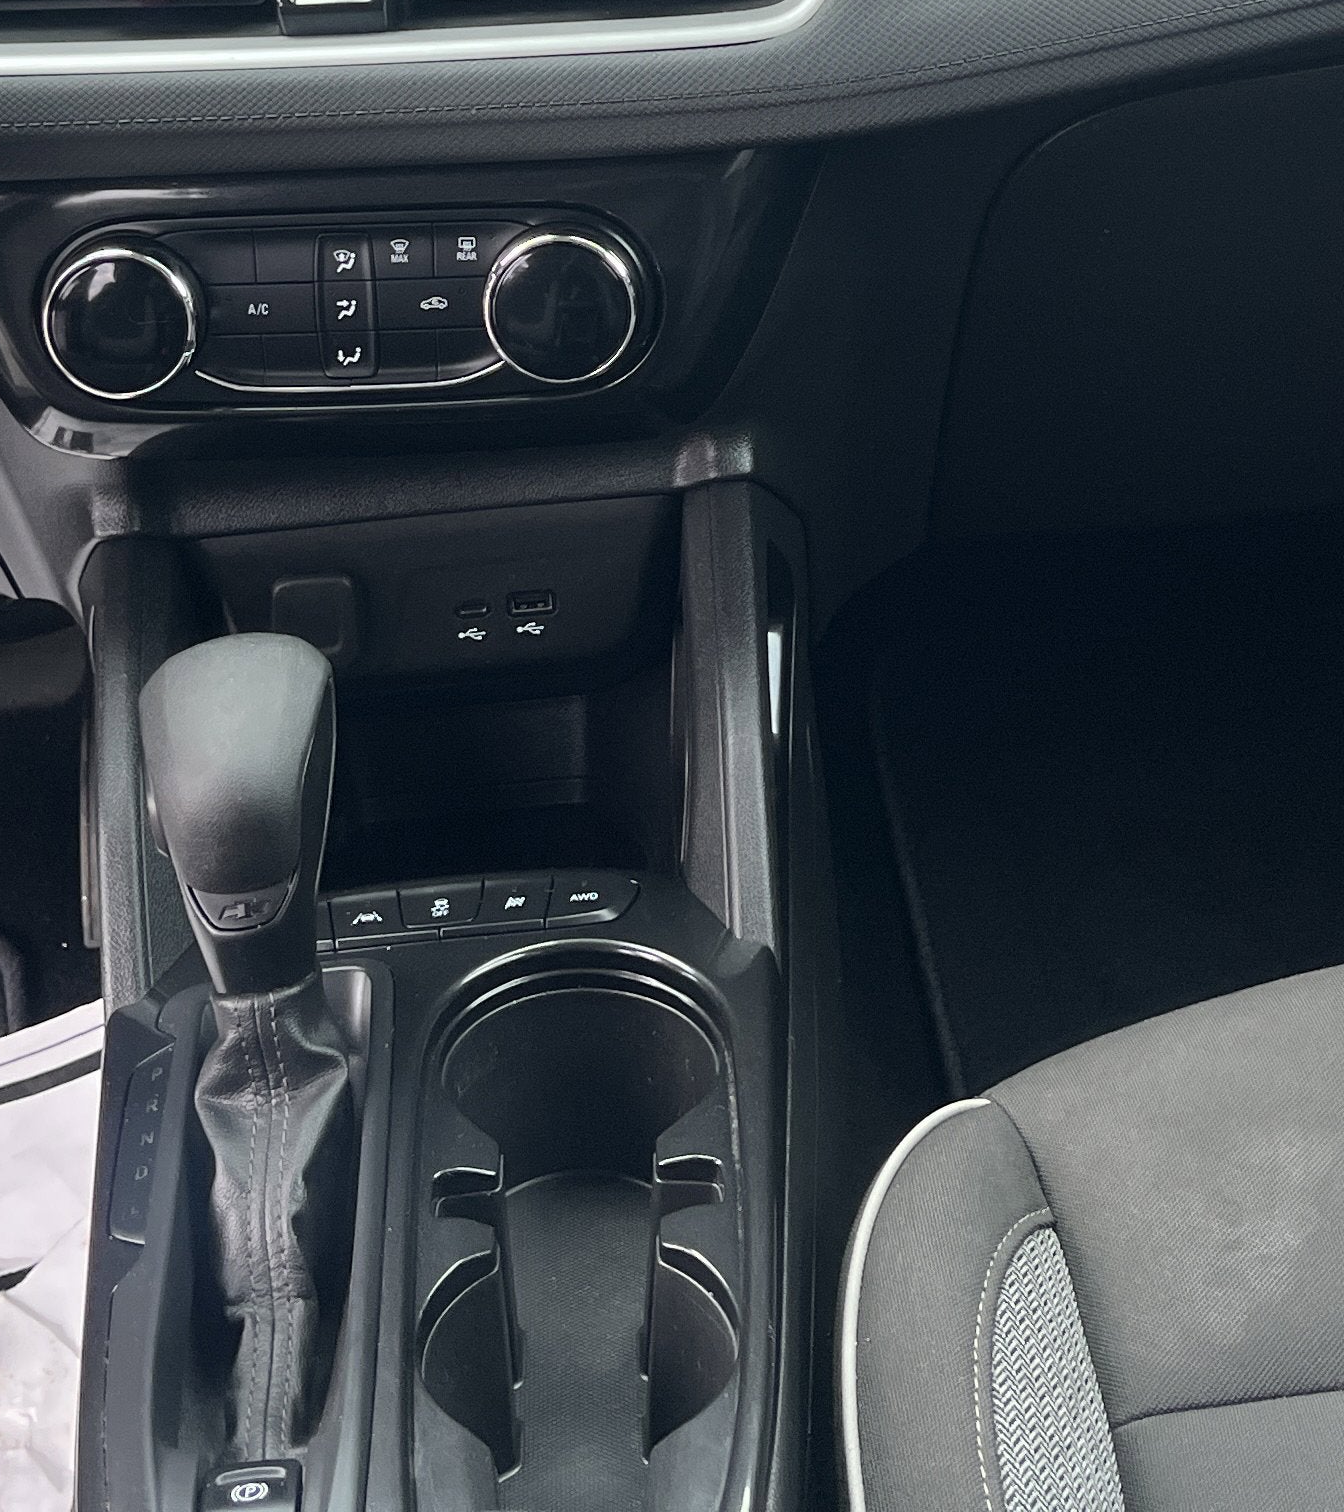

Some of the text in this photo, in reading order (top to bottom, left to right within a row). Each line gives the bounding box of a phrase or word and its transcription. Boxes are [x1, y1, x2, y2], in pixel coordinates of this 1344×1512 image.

[390, 253, 409, 263] MAX
[456, 251, 477, 261] REAR
[247, 302, 269, 316] A/C
[569, 891, 599, 903] AWD
[151, 1066, 163, 1081] P
[140, 1130, 155, 1146] N
[134, 1165, 149, 1181] D
